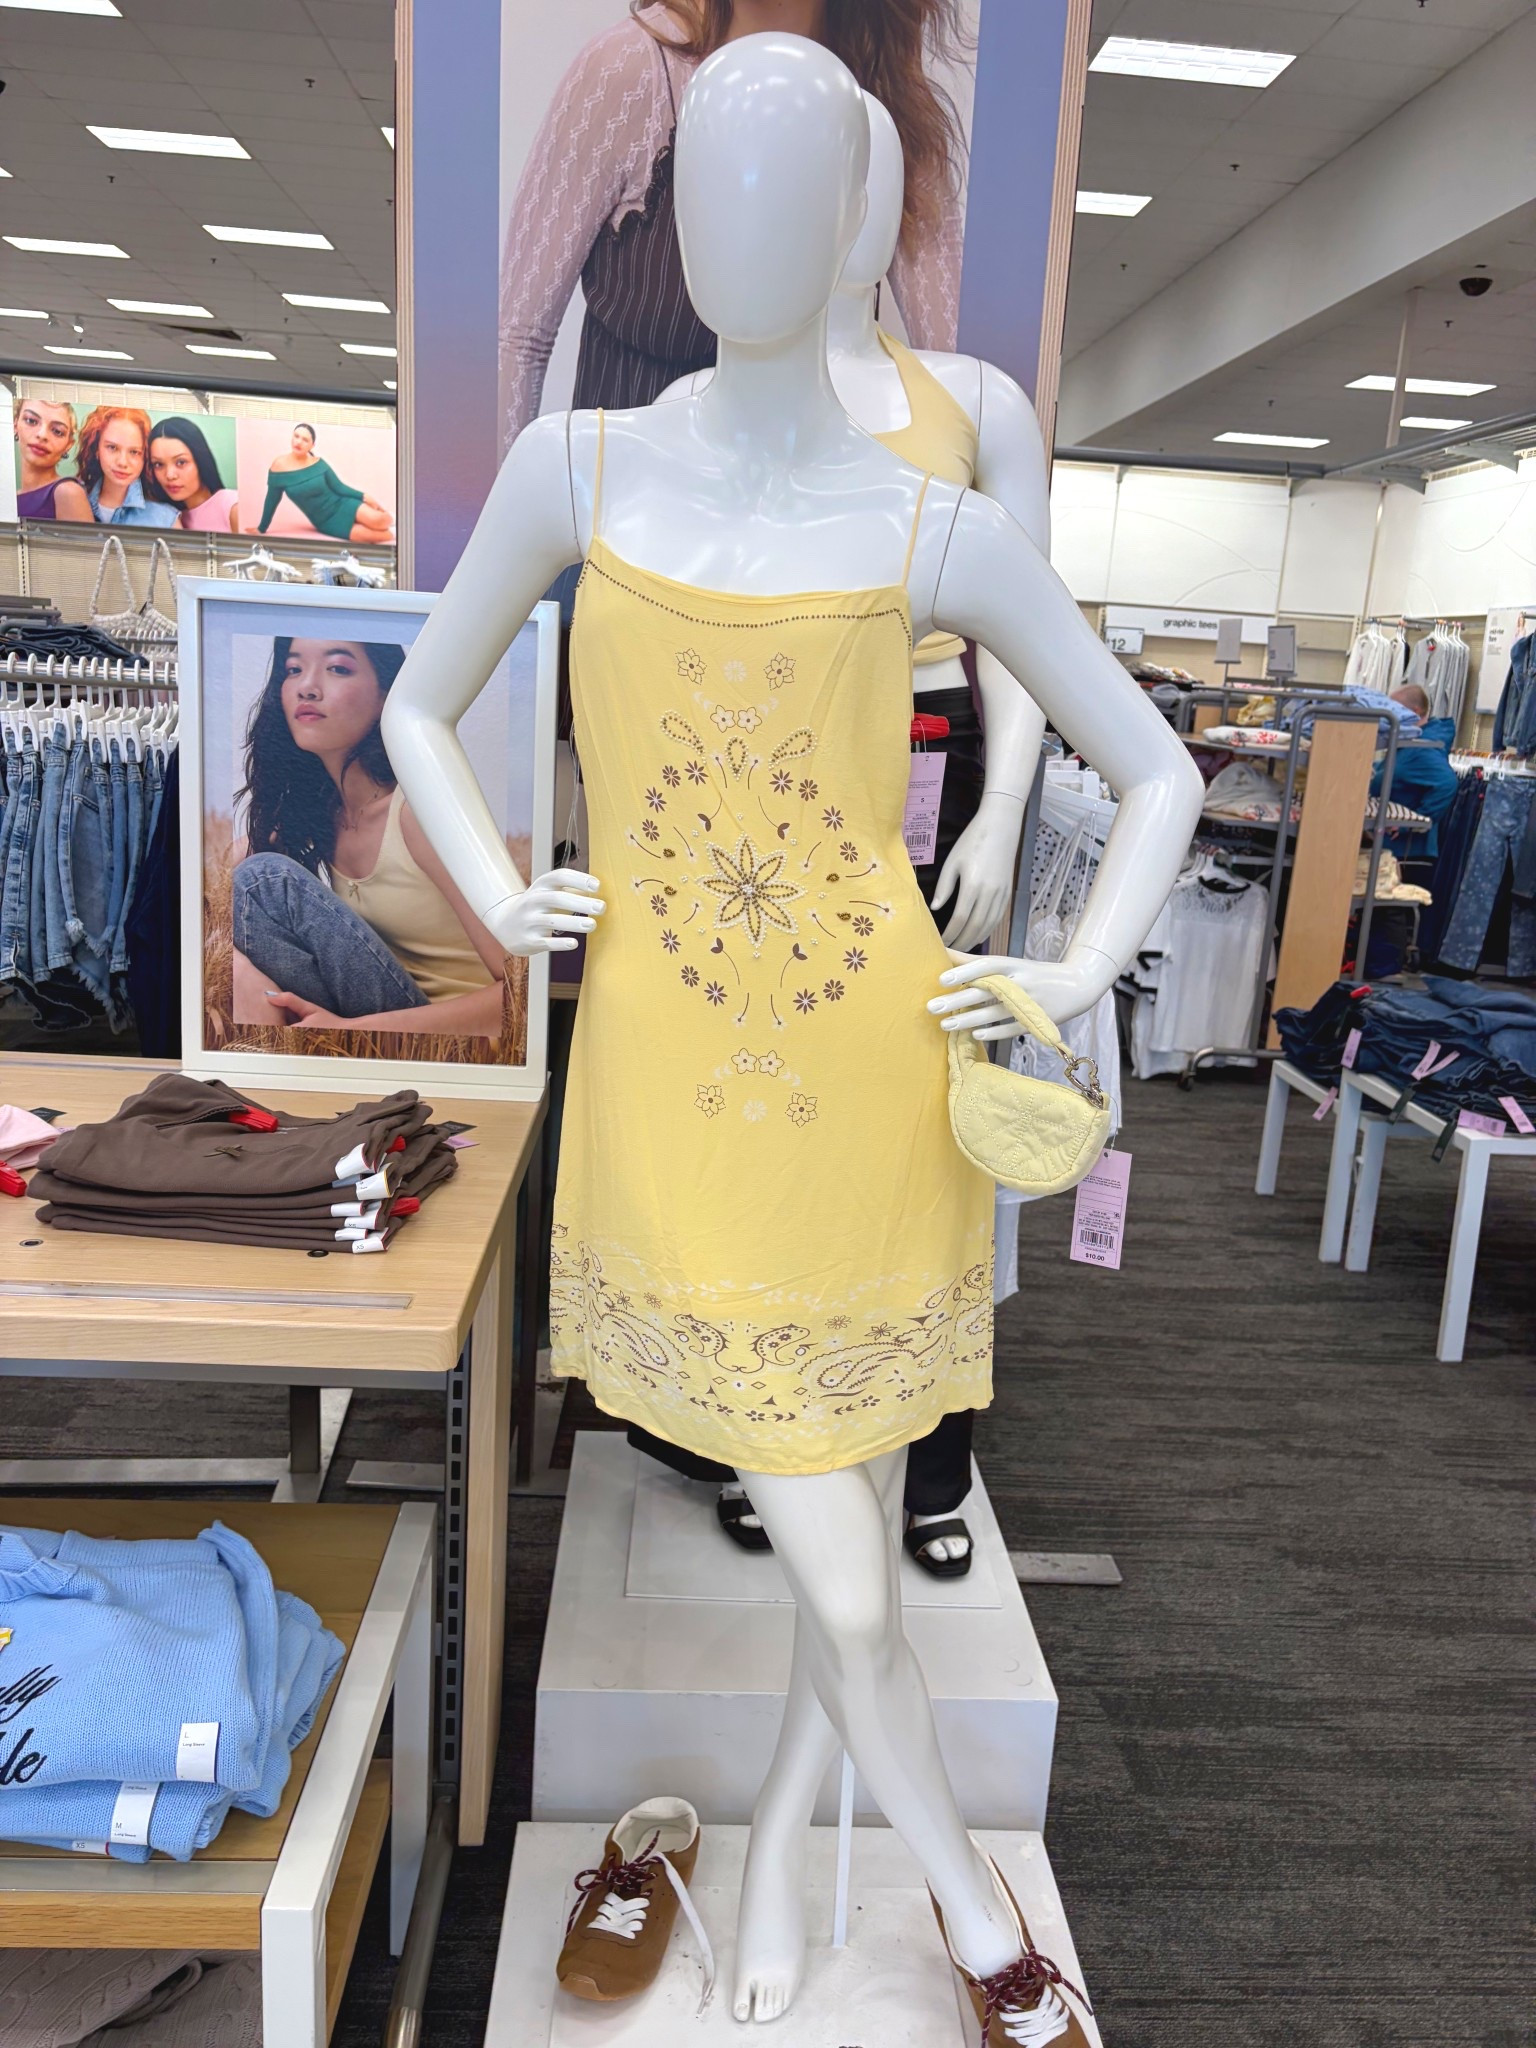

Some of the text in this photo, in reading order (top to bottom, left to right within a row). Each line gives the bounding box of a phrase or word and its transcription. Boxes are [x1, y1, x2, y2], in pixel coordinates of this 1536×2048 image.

[1163, 618, 1218, 630] graphic tees
[1085, 1252, 1105, 1262] $10.00
[184, 1731, 190, 1739] L
